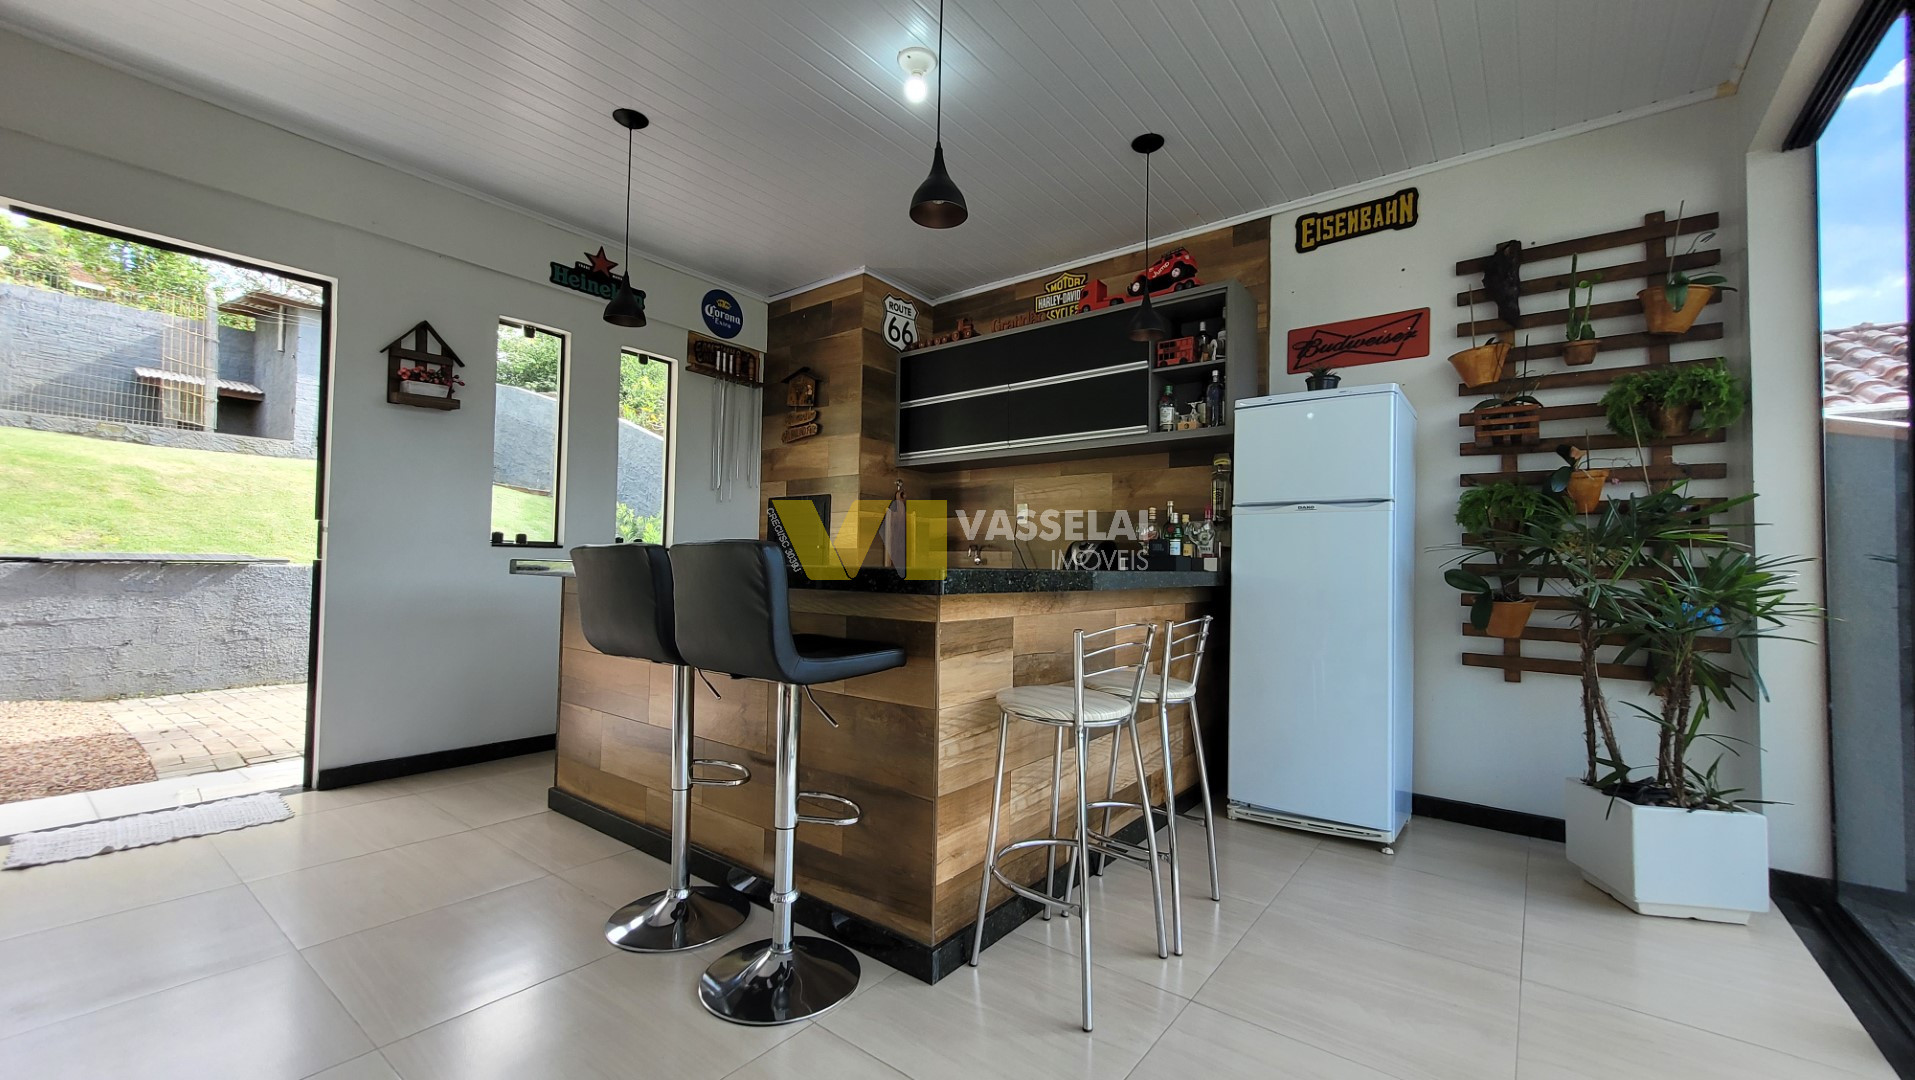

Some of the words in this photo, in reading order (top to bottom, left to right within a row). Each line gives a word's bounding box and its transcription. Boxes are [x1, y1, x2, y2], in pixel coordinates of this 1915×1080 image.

[1301, 192, 1414, 249] EISENBAHN
[1050, 275, 1081, 293] MOTOR
[888, 301, 912, 317] ROUTE
[1038, 288, 1083, 310] HARLEY-DAVID
[704, 303, 741, 325] Corona
[888, 315, 914, 346] 66
[1292, 329, 1418, 359] Budweiser
